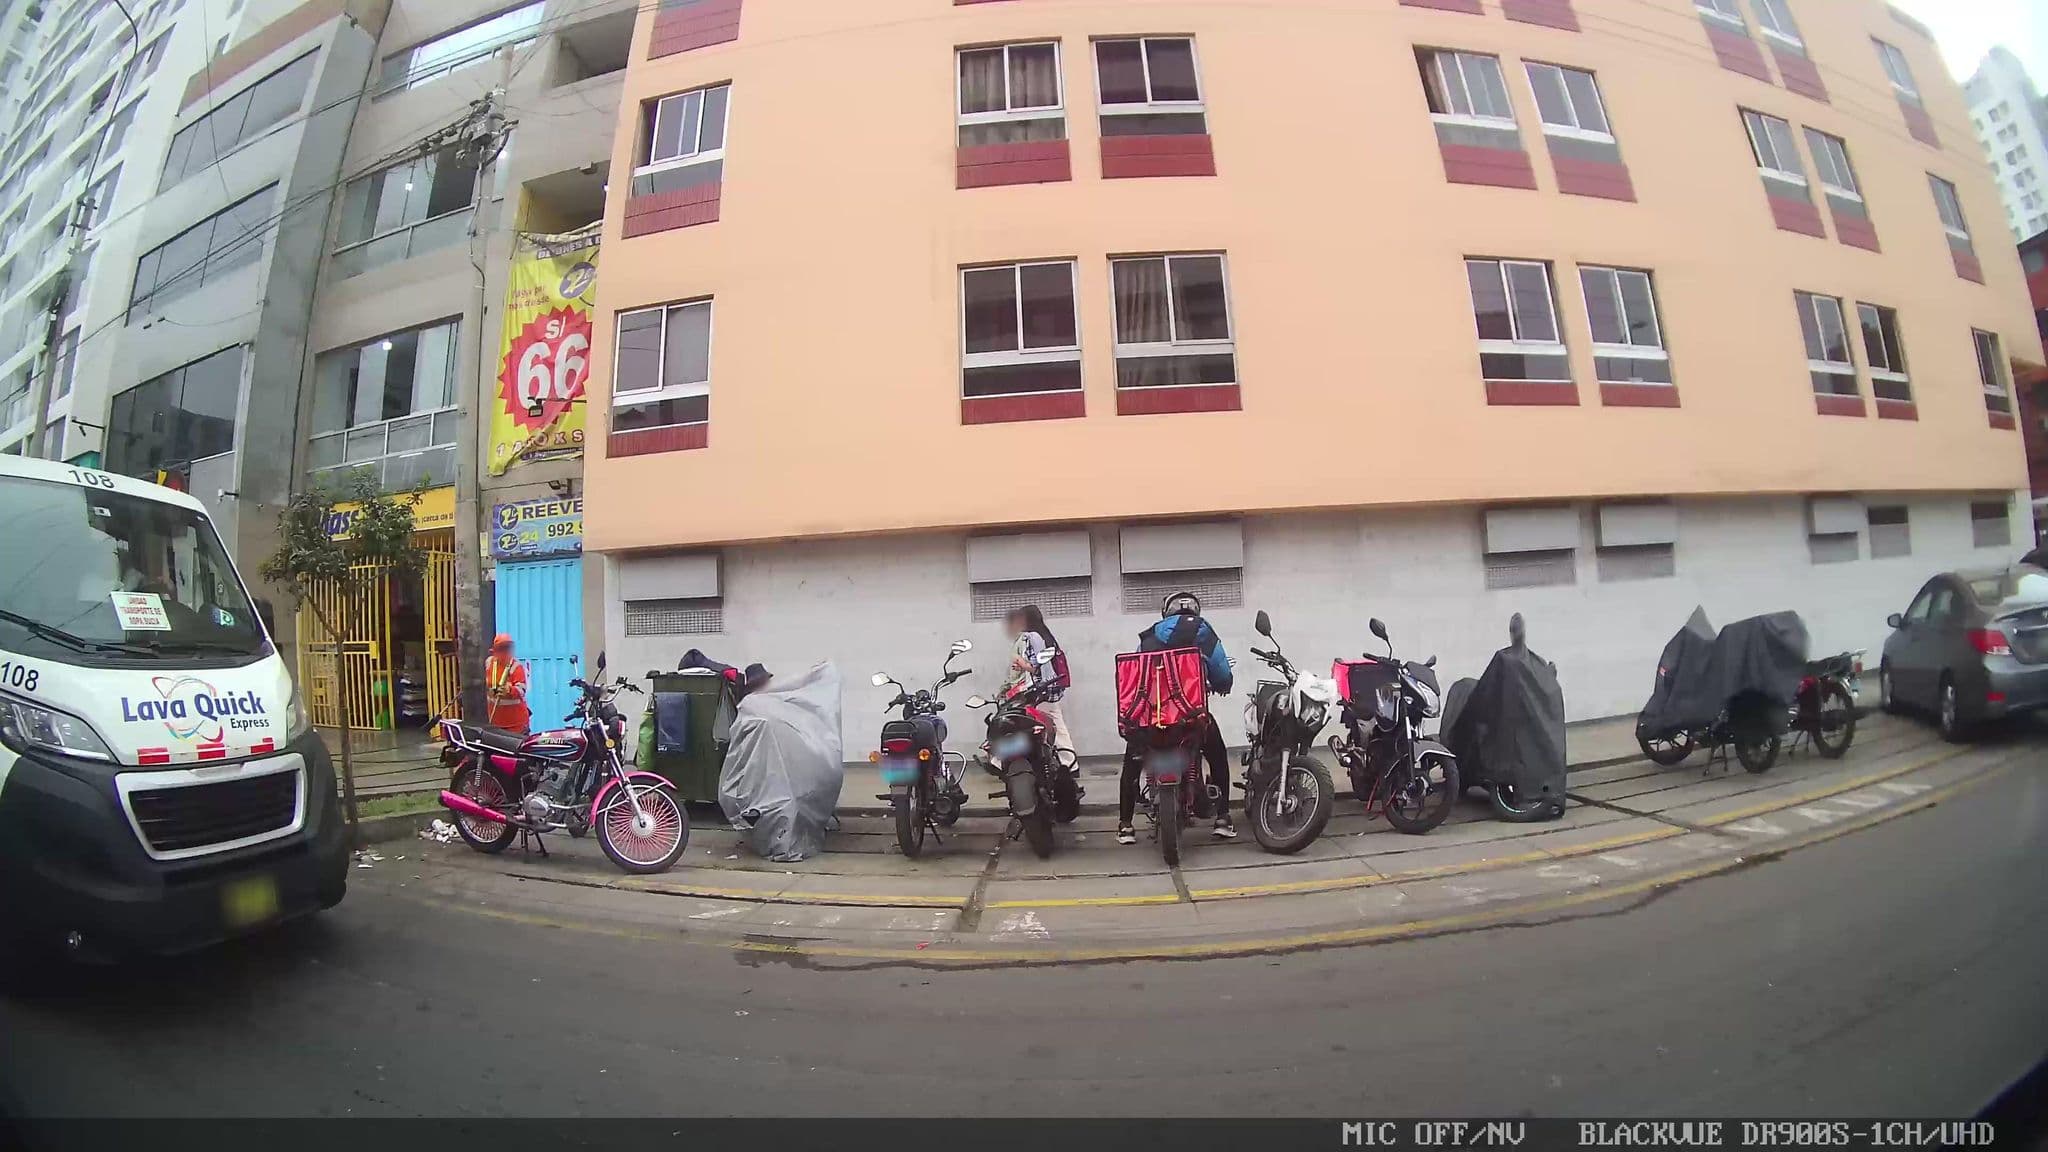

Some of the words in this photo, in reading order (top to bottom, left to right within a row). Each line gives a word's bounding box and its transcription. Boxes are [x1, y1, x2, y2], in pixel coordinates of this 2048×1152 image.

[545, 316, 566, 339] S/
[517, 333, 589, 411] 66
[68, 469, 115, 489] 108
[548, 522, 574, 537] 992
[1, 661, 39, 692] 108
[121, 697, 187, 722] Lava
[193, 691, 266, 722] Quick
[230, 718, 270, 731] Express
